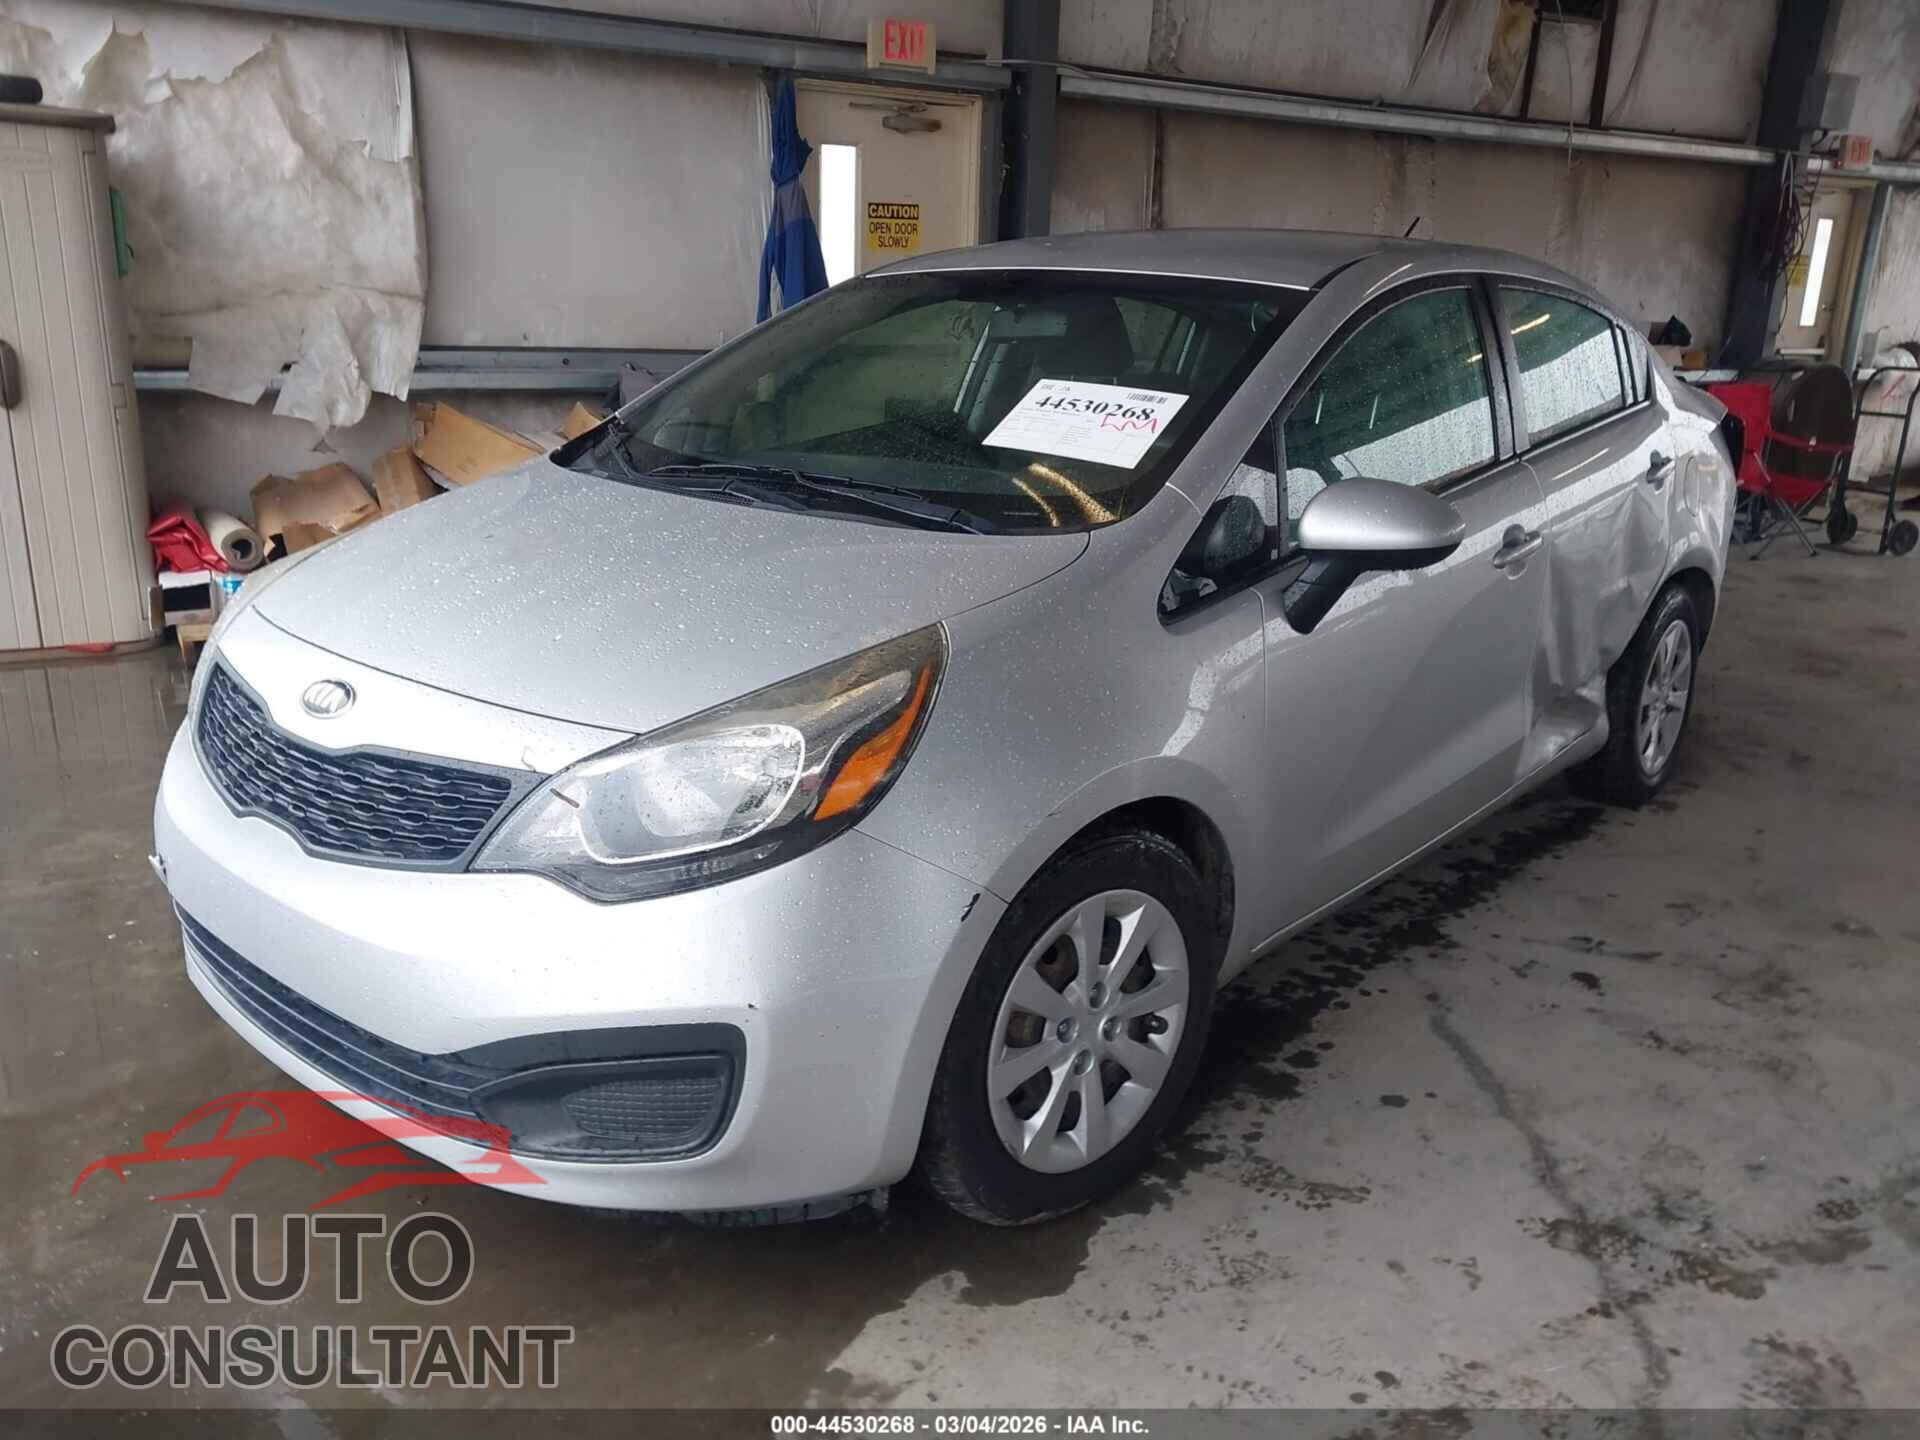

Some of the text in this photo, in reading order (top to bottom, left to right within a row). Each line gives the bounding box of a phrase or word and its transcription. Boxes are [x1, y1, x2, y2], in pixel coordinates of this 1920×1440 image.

[885, 19, 927, 63] EXIT
[870, 204, 918, 218] CAUTION
[869, 222, 918, 236] OPEN DOOR
[878, 236, 909, 248] SLOWLY
[1034, 396, 1156, 421] 44530268
